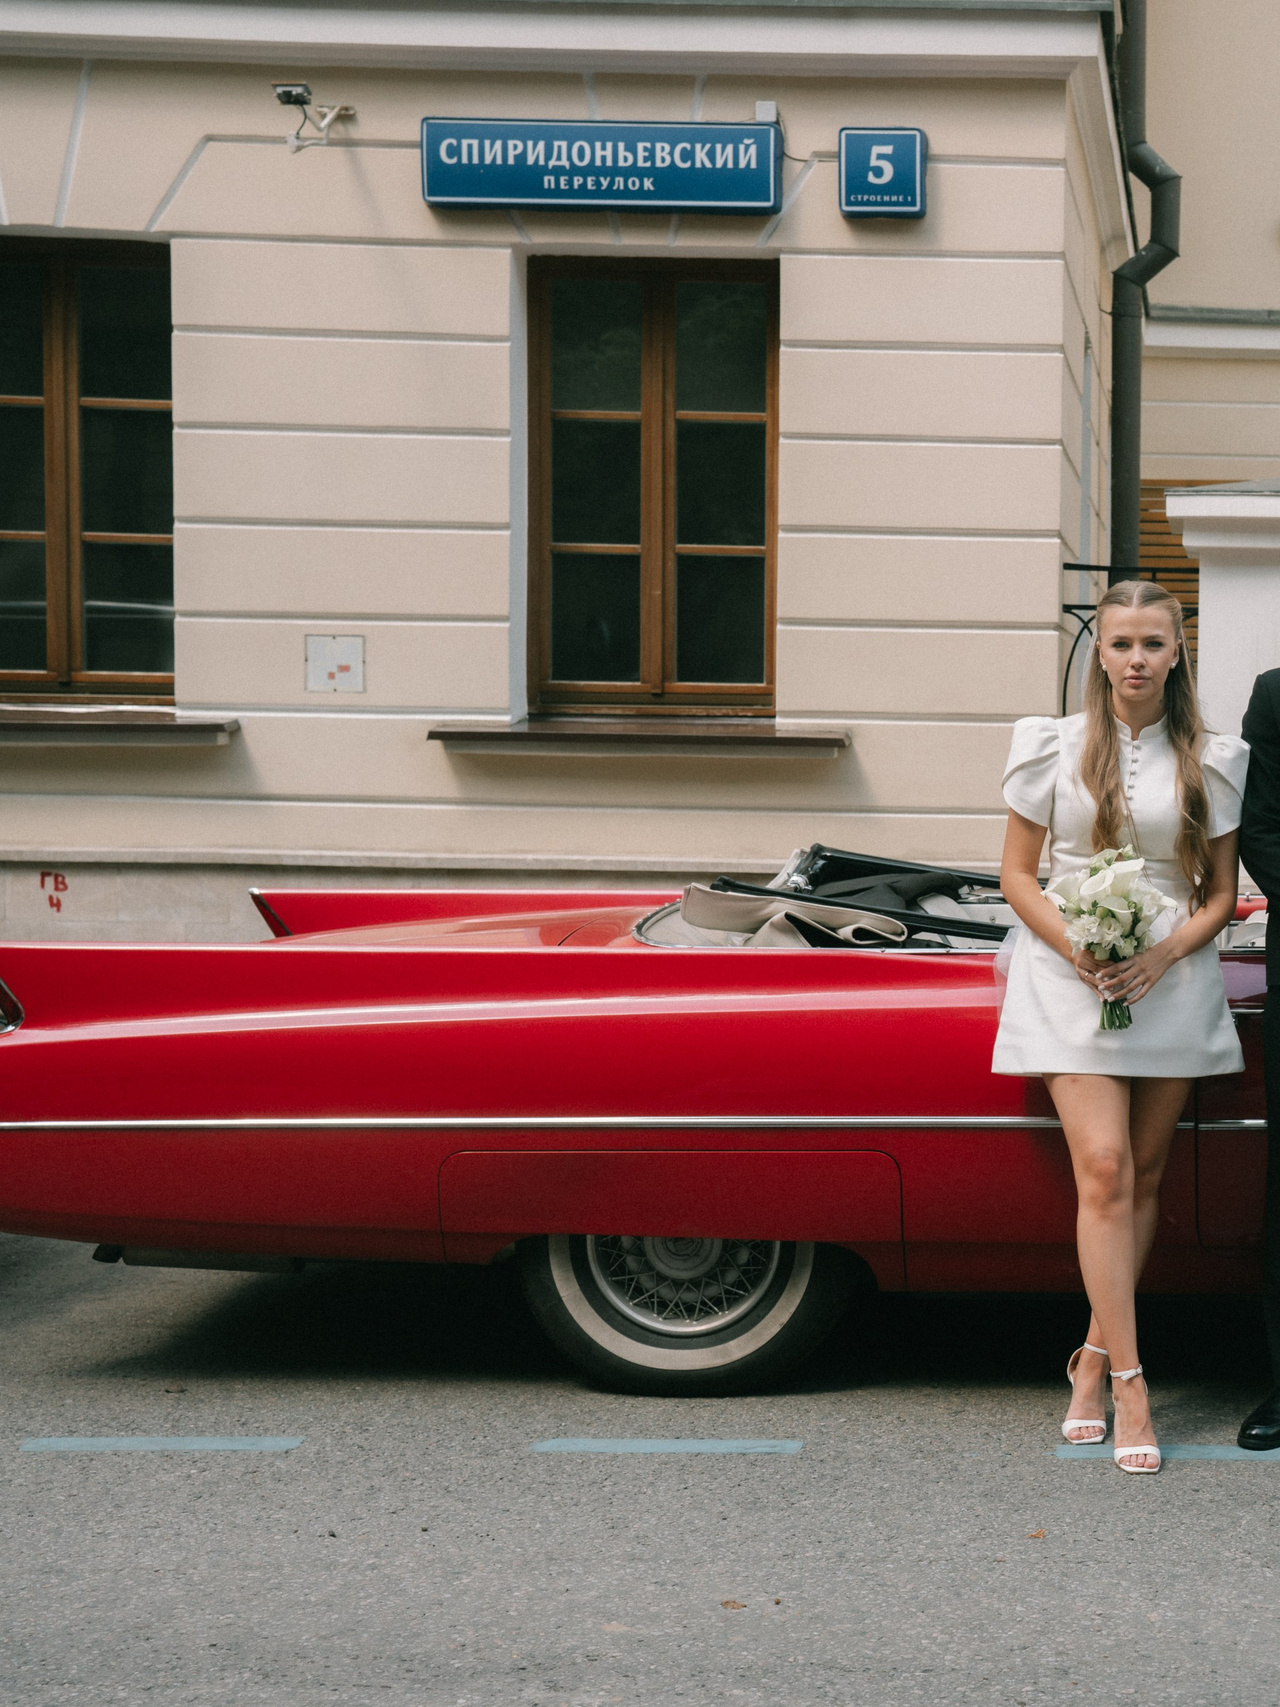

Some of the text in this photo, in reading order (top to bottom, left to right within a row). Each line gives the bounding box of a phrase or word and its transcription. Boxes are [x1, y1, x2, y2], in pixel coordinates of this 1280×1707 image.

[439, 138, 758, 171] СПИРИДОНЬЕВСКИЙ
[867, 145, 894, 185] 5
[543, 175, 655, 191] ПЕРЕУЛОК
[850, 194, 905, 203] СТРОЕНИЕ
